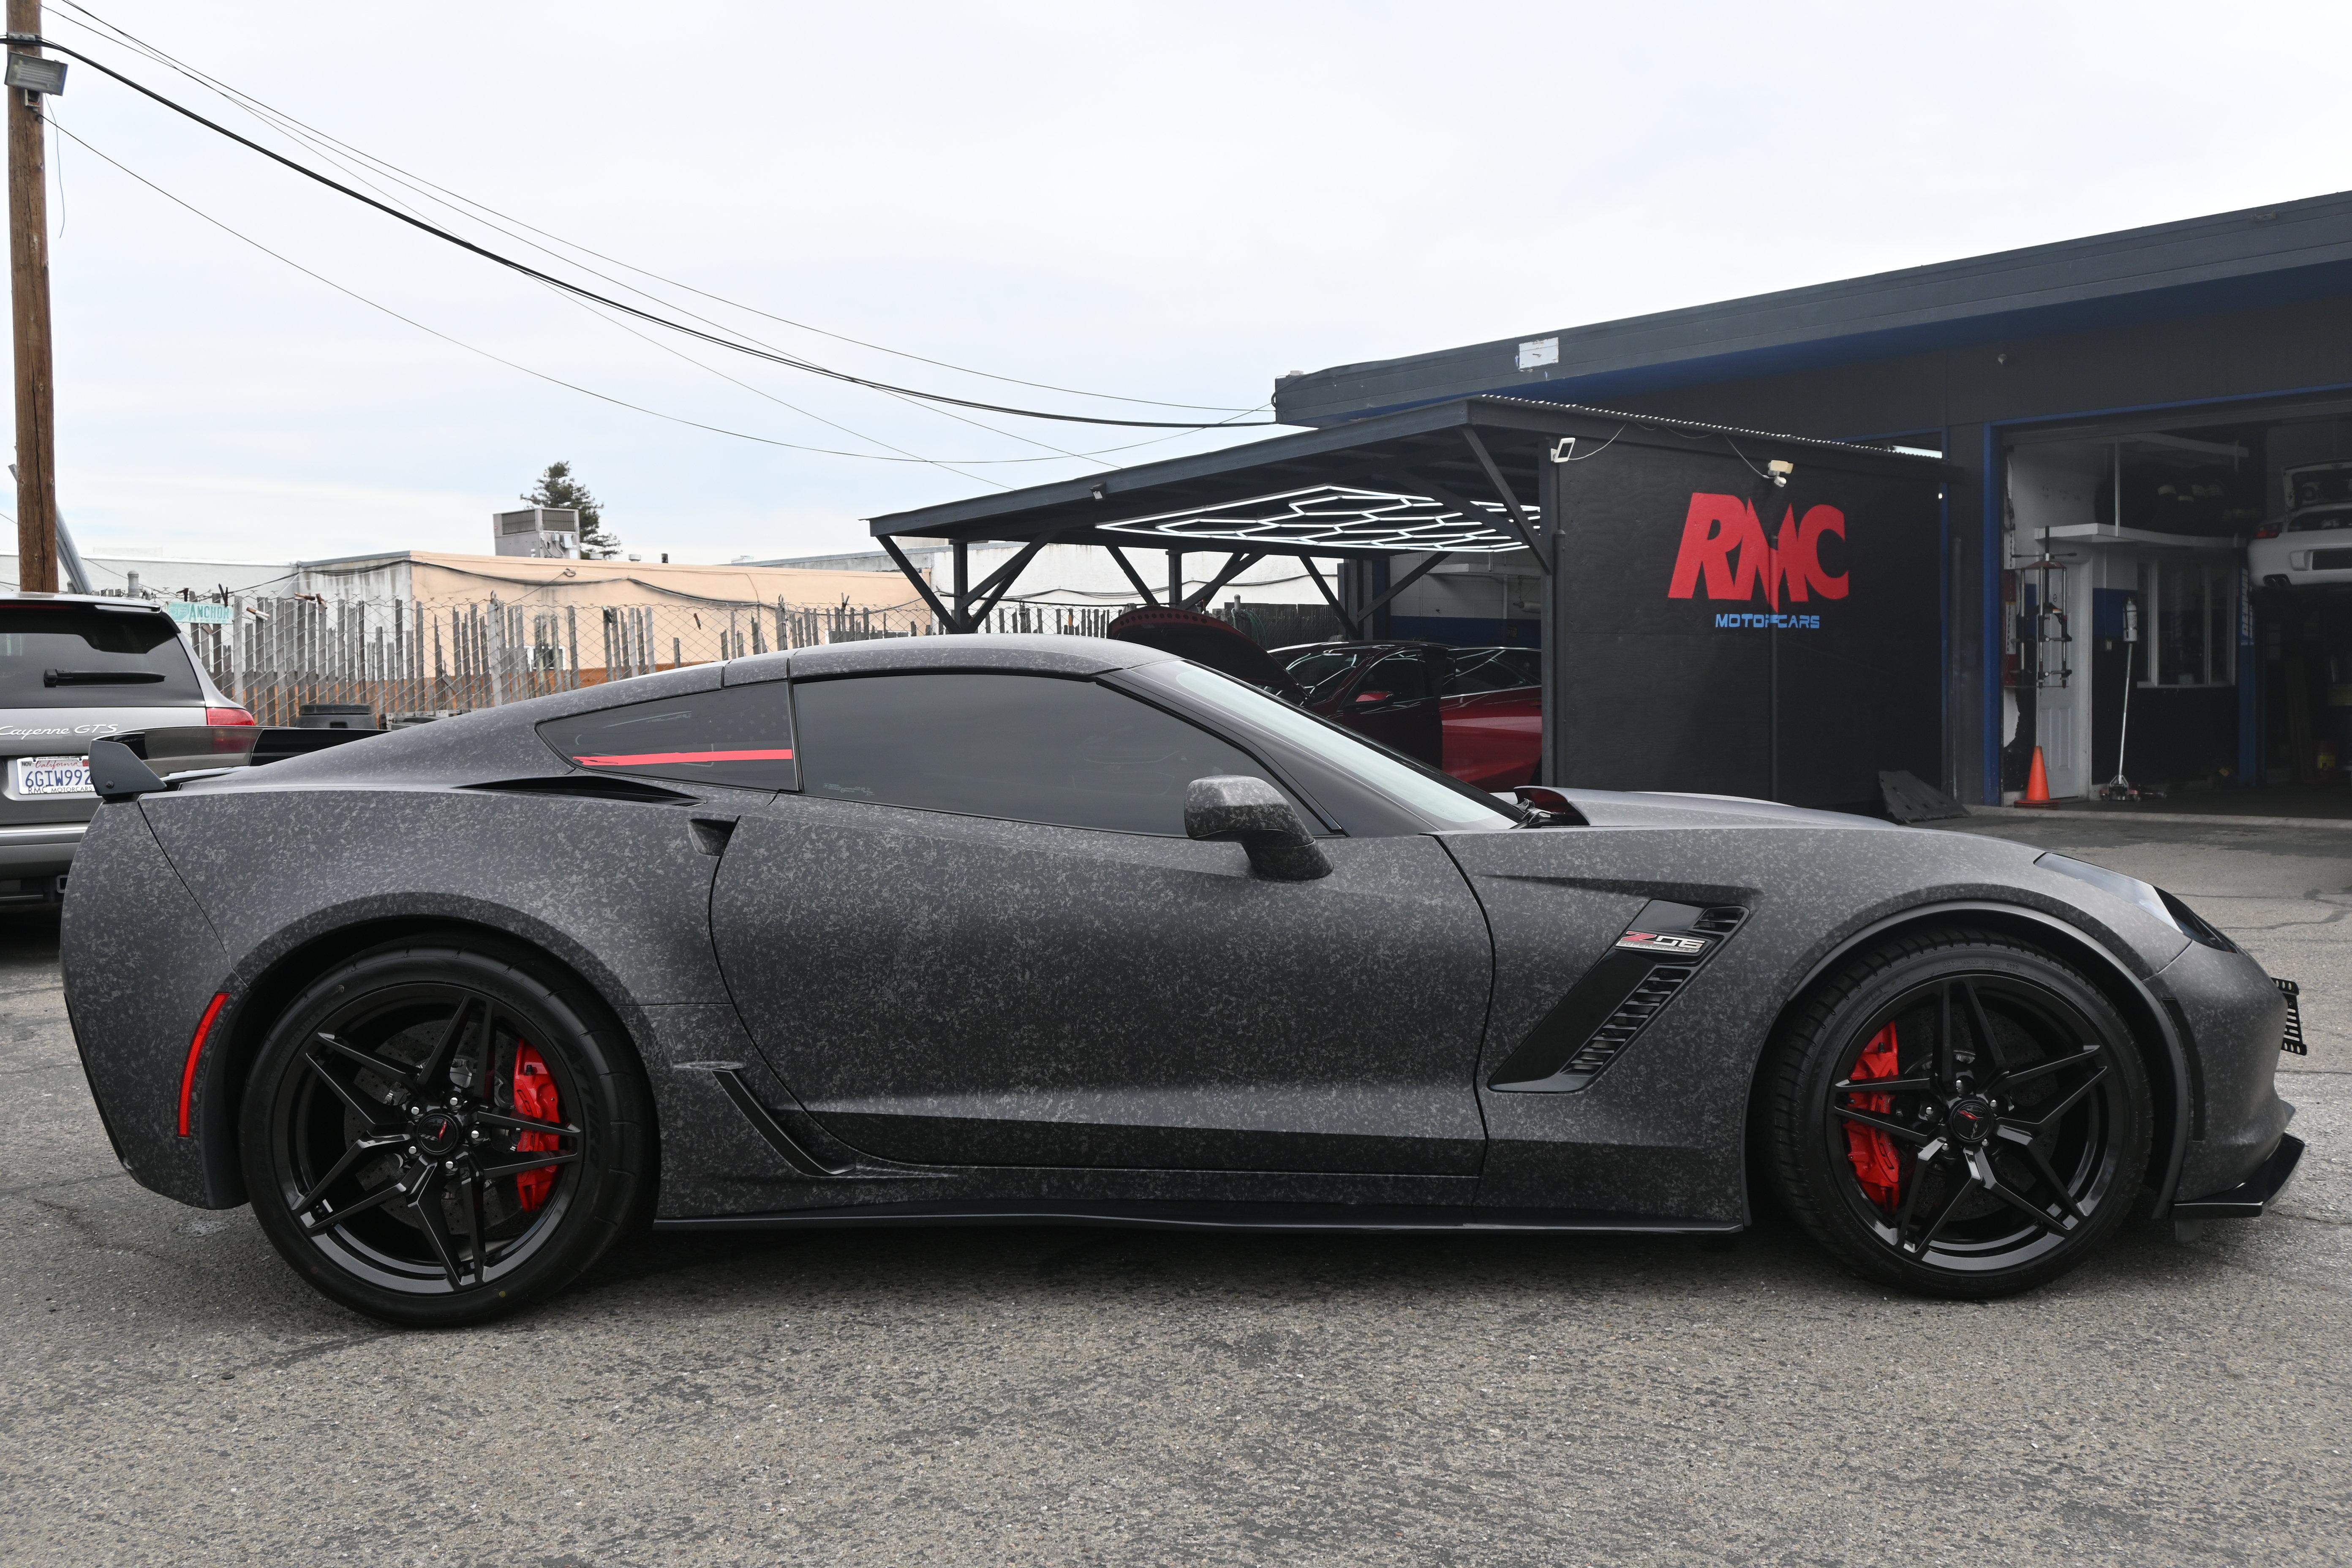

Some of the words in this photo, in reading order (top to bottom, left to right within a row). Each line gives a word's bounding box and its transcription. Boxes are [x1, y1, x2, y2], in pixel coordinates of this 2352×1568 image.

[1668, 493, 1849, 603] RMC
[189, 604, 229, 621] ANCHOR
[1715, 614, 1820, 629] MOTORCARS
[0, 726, 70, 740] Cayenne
[74, 724, 118, 734] GTS
[35, 760, 82, 770] California
[25, 769, 93, 787] 6GIW992
[1619, 941, 1697, 952] SUPERCHARGED
[1620, 931, 1706, 949] Z06
